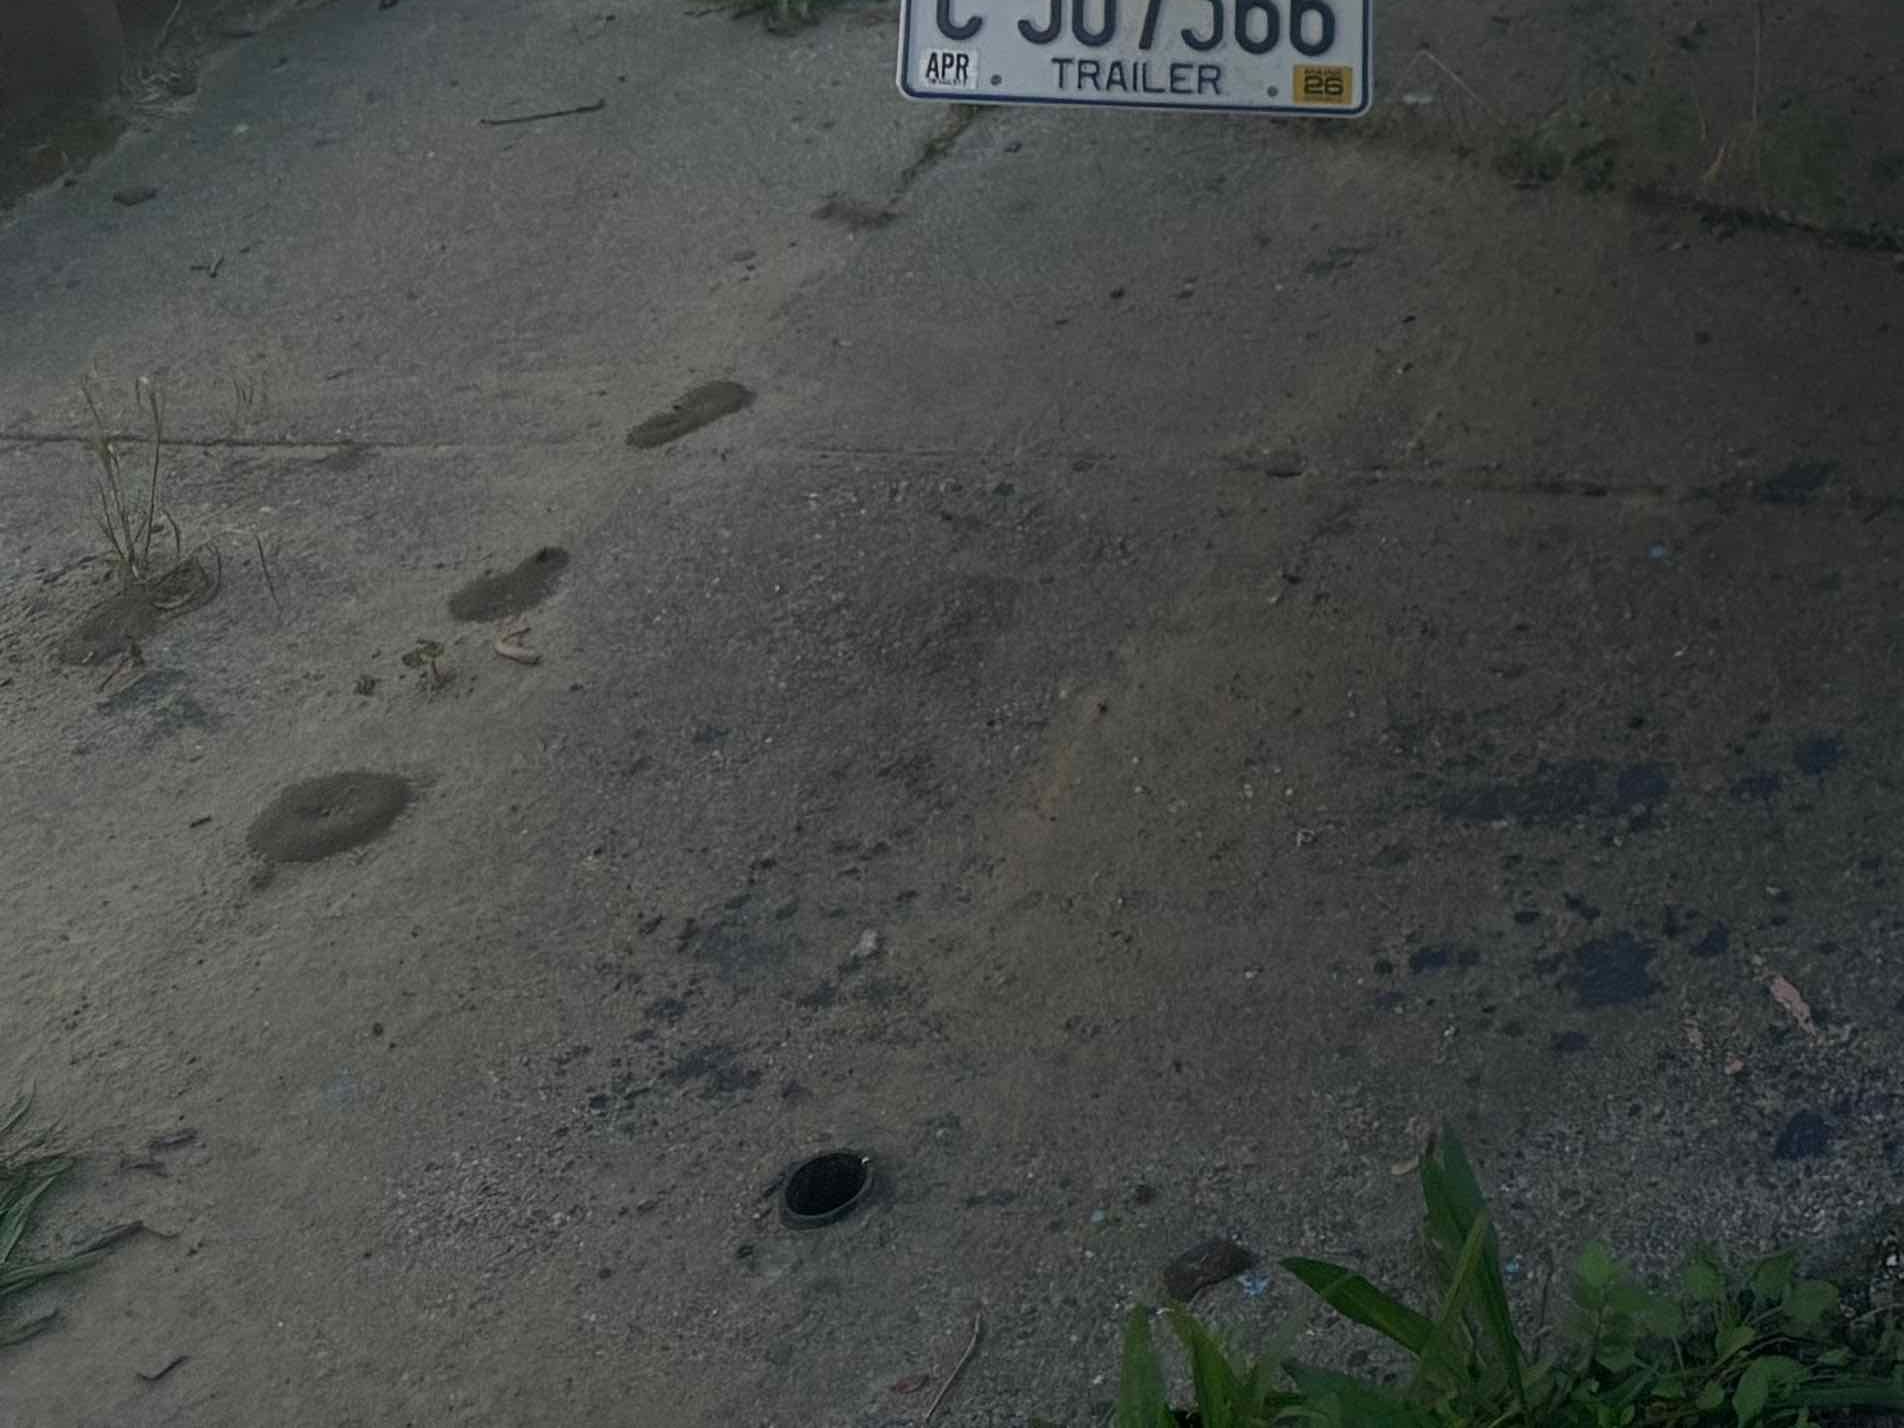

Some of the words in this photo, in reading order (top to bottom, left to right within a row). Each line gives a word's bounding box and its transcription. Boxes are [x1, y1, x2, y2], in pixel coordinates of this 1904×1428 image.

[926, 51, 970, 80] APR
[1051, 57, 1223, 96] TRAILER
[1303, 75, 1345, 96] 26
